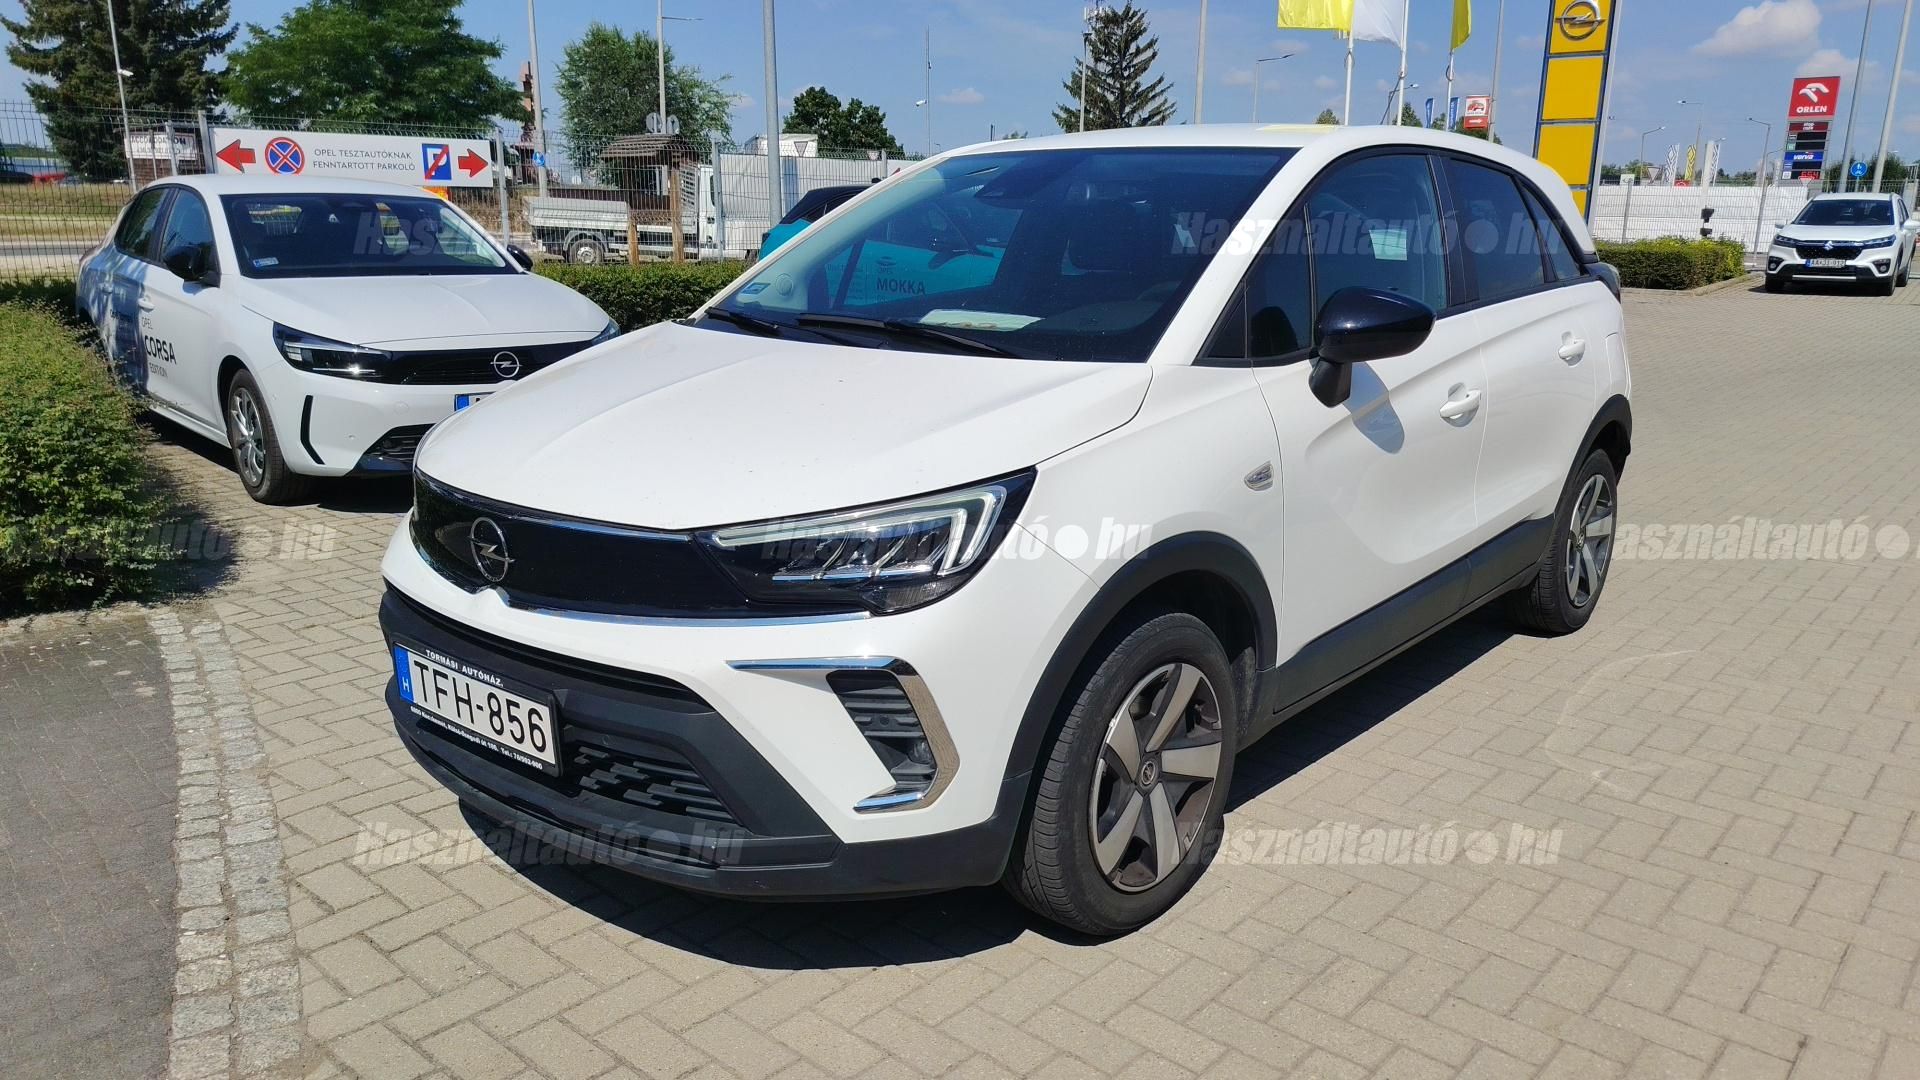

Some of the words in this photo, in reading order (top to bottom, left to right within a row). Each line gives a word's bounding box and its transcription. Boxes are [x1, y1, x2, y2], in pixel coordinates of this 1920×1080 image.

[1796, 105, 1827, 114] ORLEN
[314, 148, 337, 157] OPEL
[339, 149, 412, 160] TESZTAUTÓKNAK
[313, 160, 376, 170] FENNTARTOTT
[377, 162, 416, 171] PARKOLÓ
[877, 277, 926, 296] MOKKA
[141, 316, 153, 330] OPEL
[144, 335, 177, 365] CORSA
[425, 649, 459, 669] TORMÁSI
[402, 677, 410, 692] H
[413, 660, 547, 754] TFH-856
